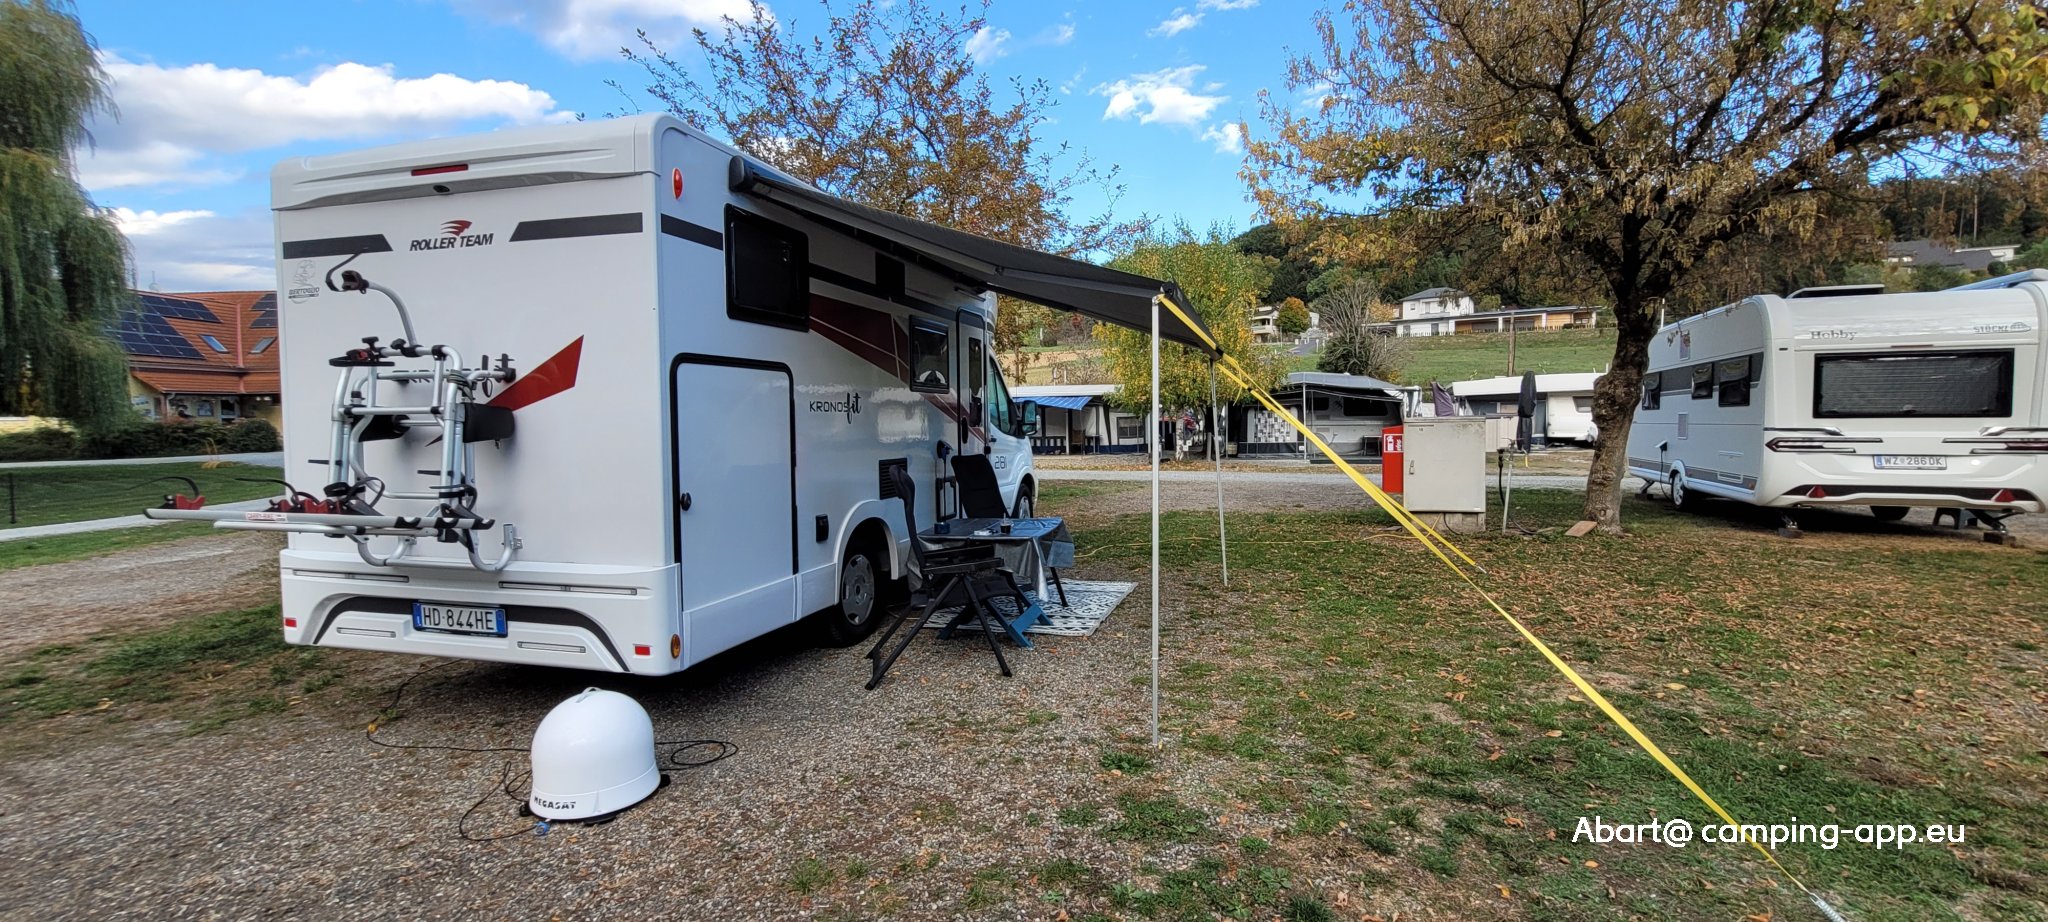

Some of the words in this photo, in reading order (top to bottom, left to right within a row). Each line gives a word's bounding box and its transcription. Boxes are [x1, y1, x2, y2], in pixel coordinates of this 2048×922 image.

[409, 236, 457, 251] ROLLER
[459, 233, 494, 248] TEAM
[1809, 329, 1857, 341] Hobby
[809, 400, 849, 413] KRONOS
[533, 795, 577, 810] MEGASAT
